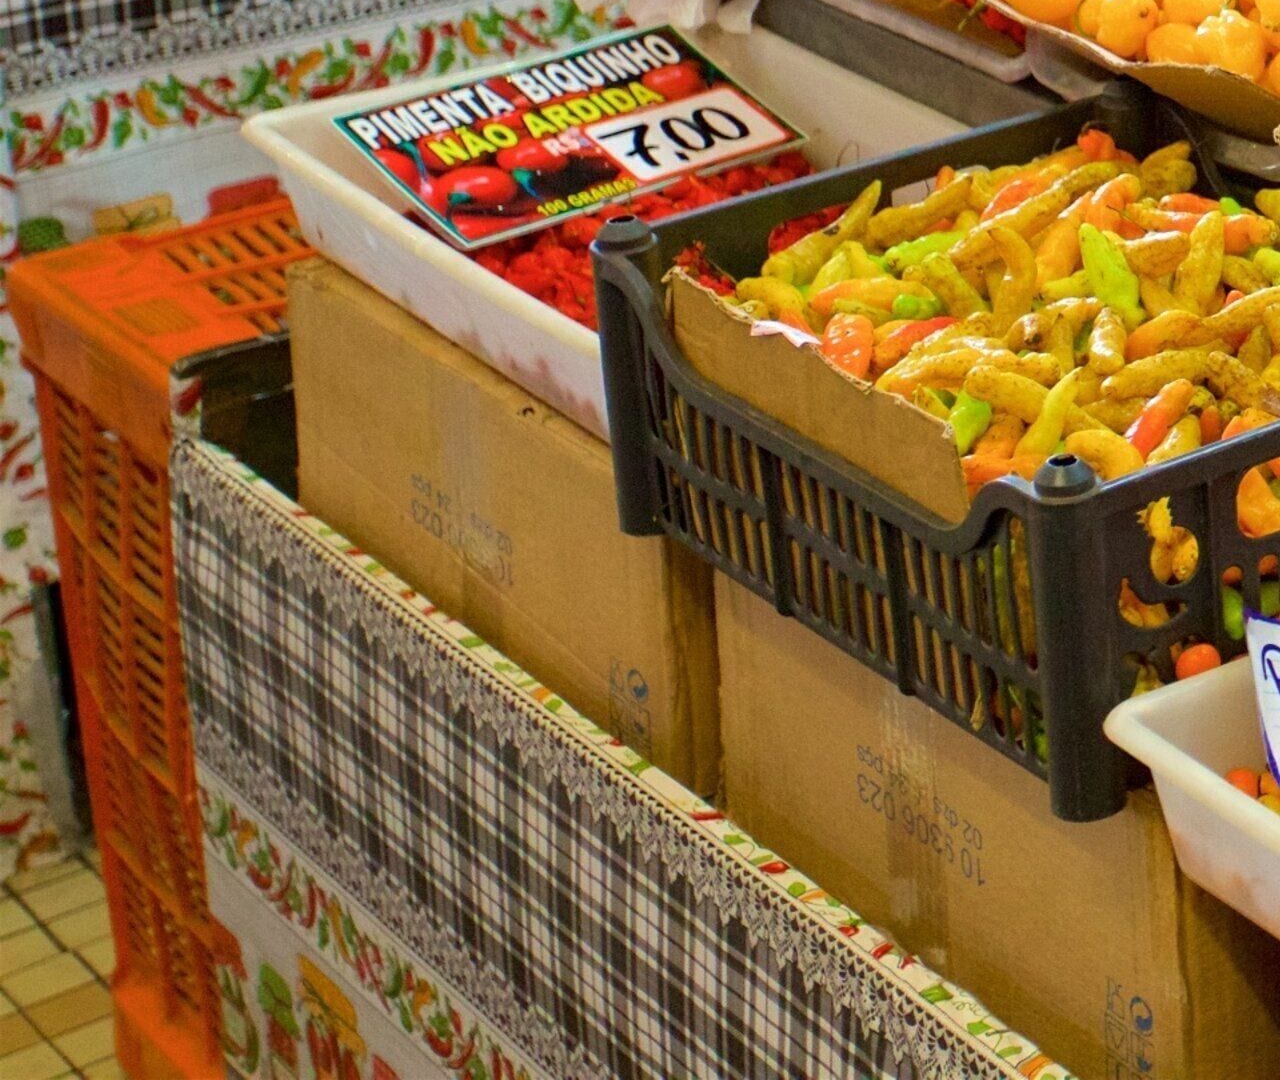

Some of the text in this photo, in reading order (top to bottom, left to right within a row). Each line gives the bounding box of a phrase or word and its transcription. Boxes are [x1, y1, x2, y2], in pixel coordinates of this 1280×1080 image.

[347, 33, 682, 150] PIMENTA BIQUINHO
[428, 81, 665, 167] NÃO ARDIDA
[597, 105, 749, 170] 7,00
[536, 178, 638, 218] 100 GRAMAS
